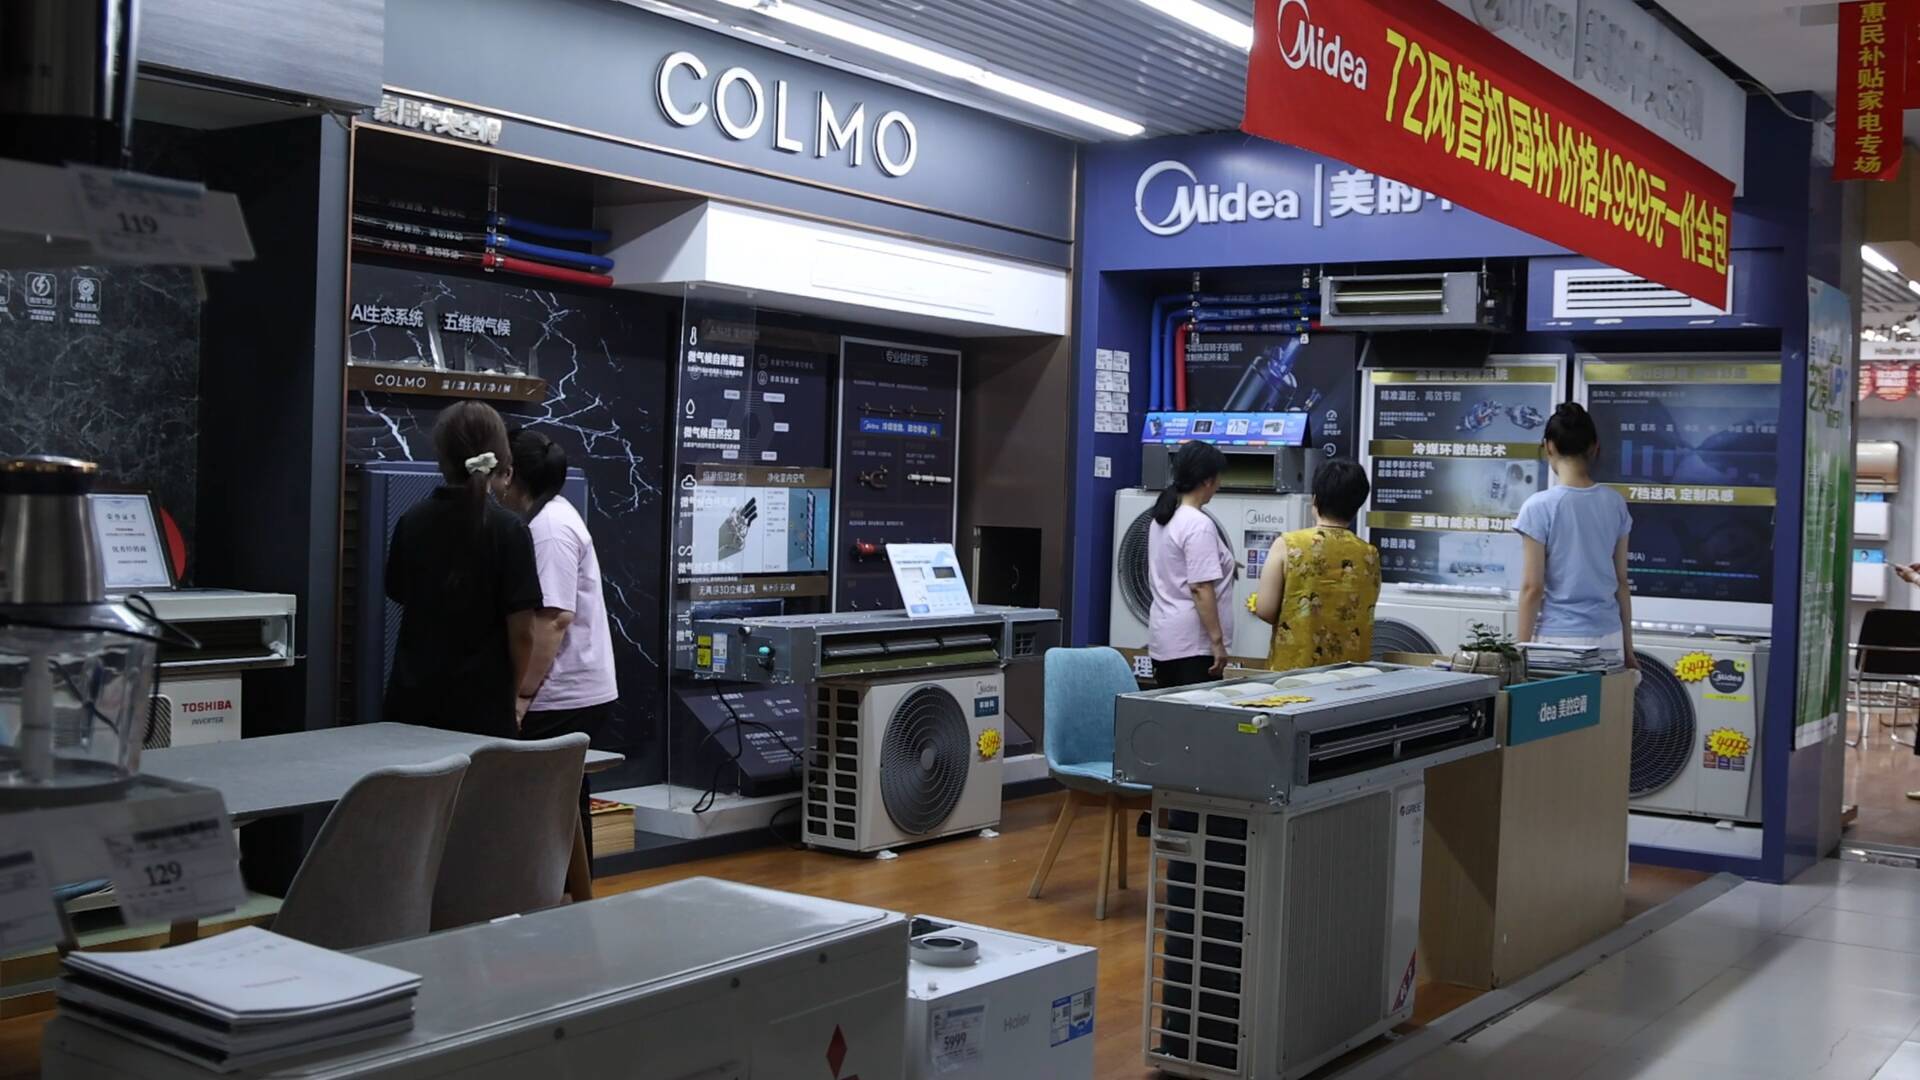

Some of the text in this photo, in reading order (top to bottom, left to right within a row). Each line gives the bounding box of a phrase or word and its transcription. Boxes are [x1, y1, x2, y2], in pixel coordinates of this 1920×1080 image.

[1277, 0, 1368, 92] Midea
[1853, 1, 1887, 174] 惠民补贴家电专场
[655, 50, 919, 178] COLMO
[1385, 28, 1728, 276] 72风管机国补价格4999元一价全包
[1134, 159, 1300, 235] Midea
[1328, 168, 1454, 217] 美的
[118, 212, 159, 234] 119
[351, 303, 425, 328] AI生态系统
[444, 312, 513, 337] 五维微气候
[373, 372, 428, 389] COLMO
[1246, 509, 1285, 525] Midea
[181, 700, 233, 713] TOSHIBA
[144, 860, 183, 887] 129
